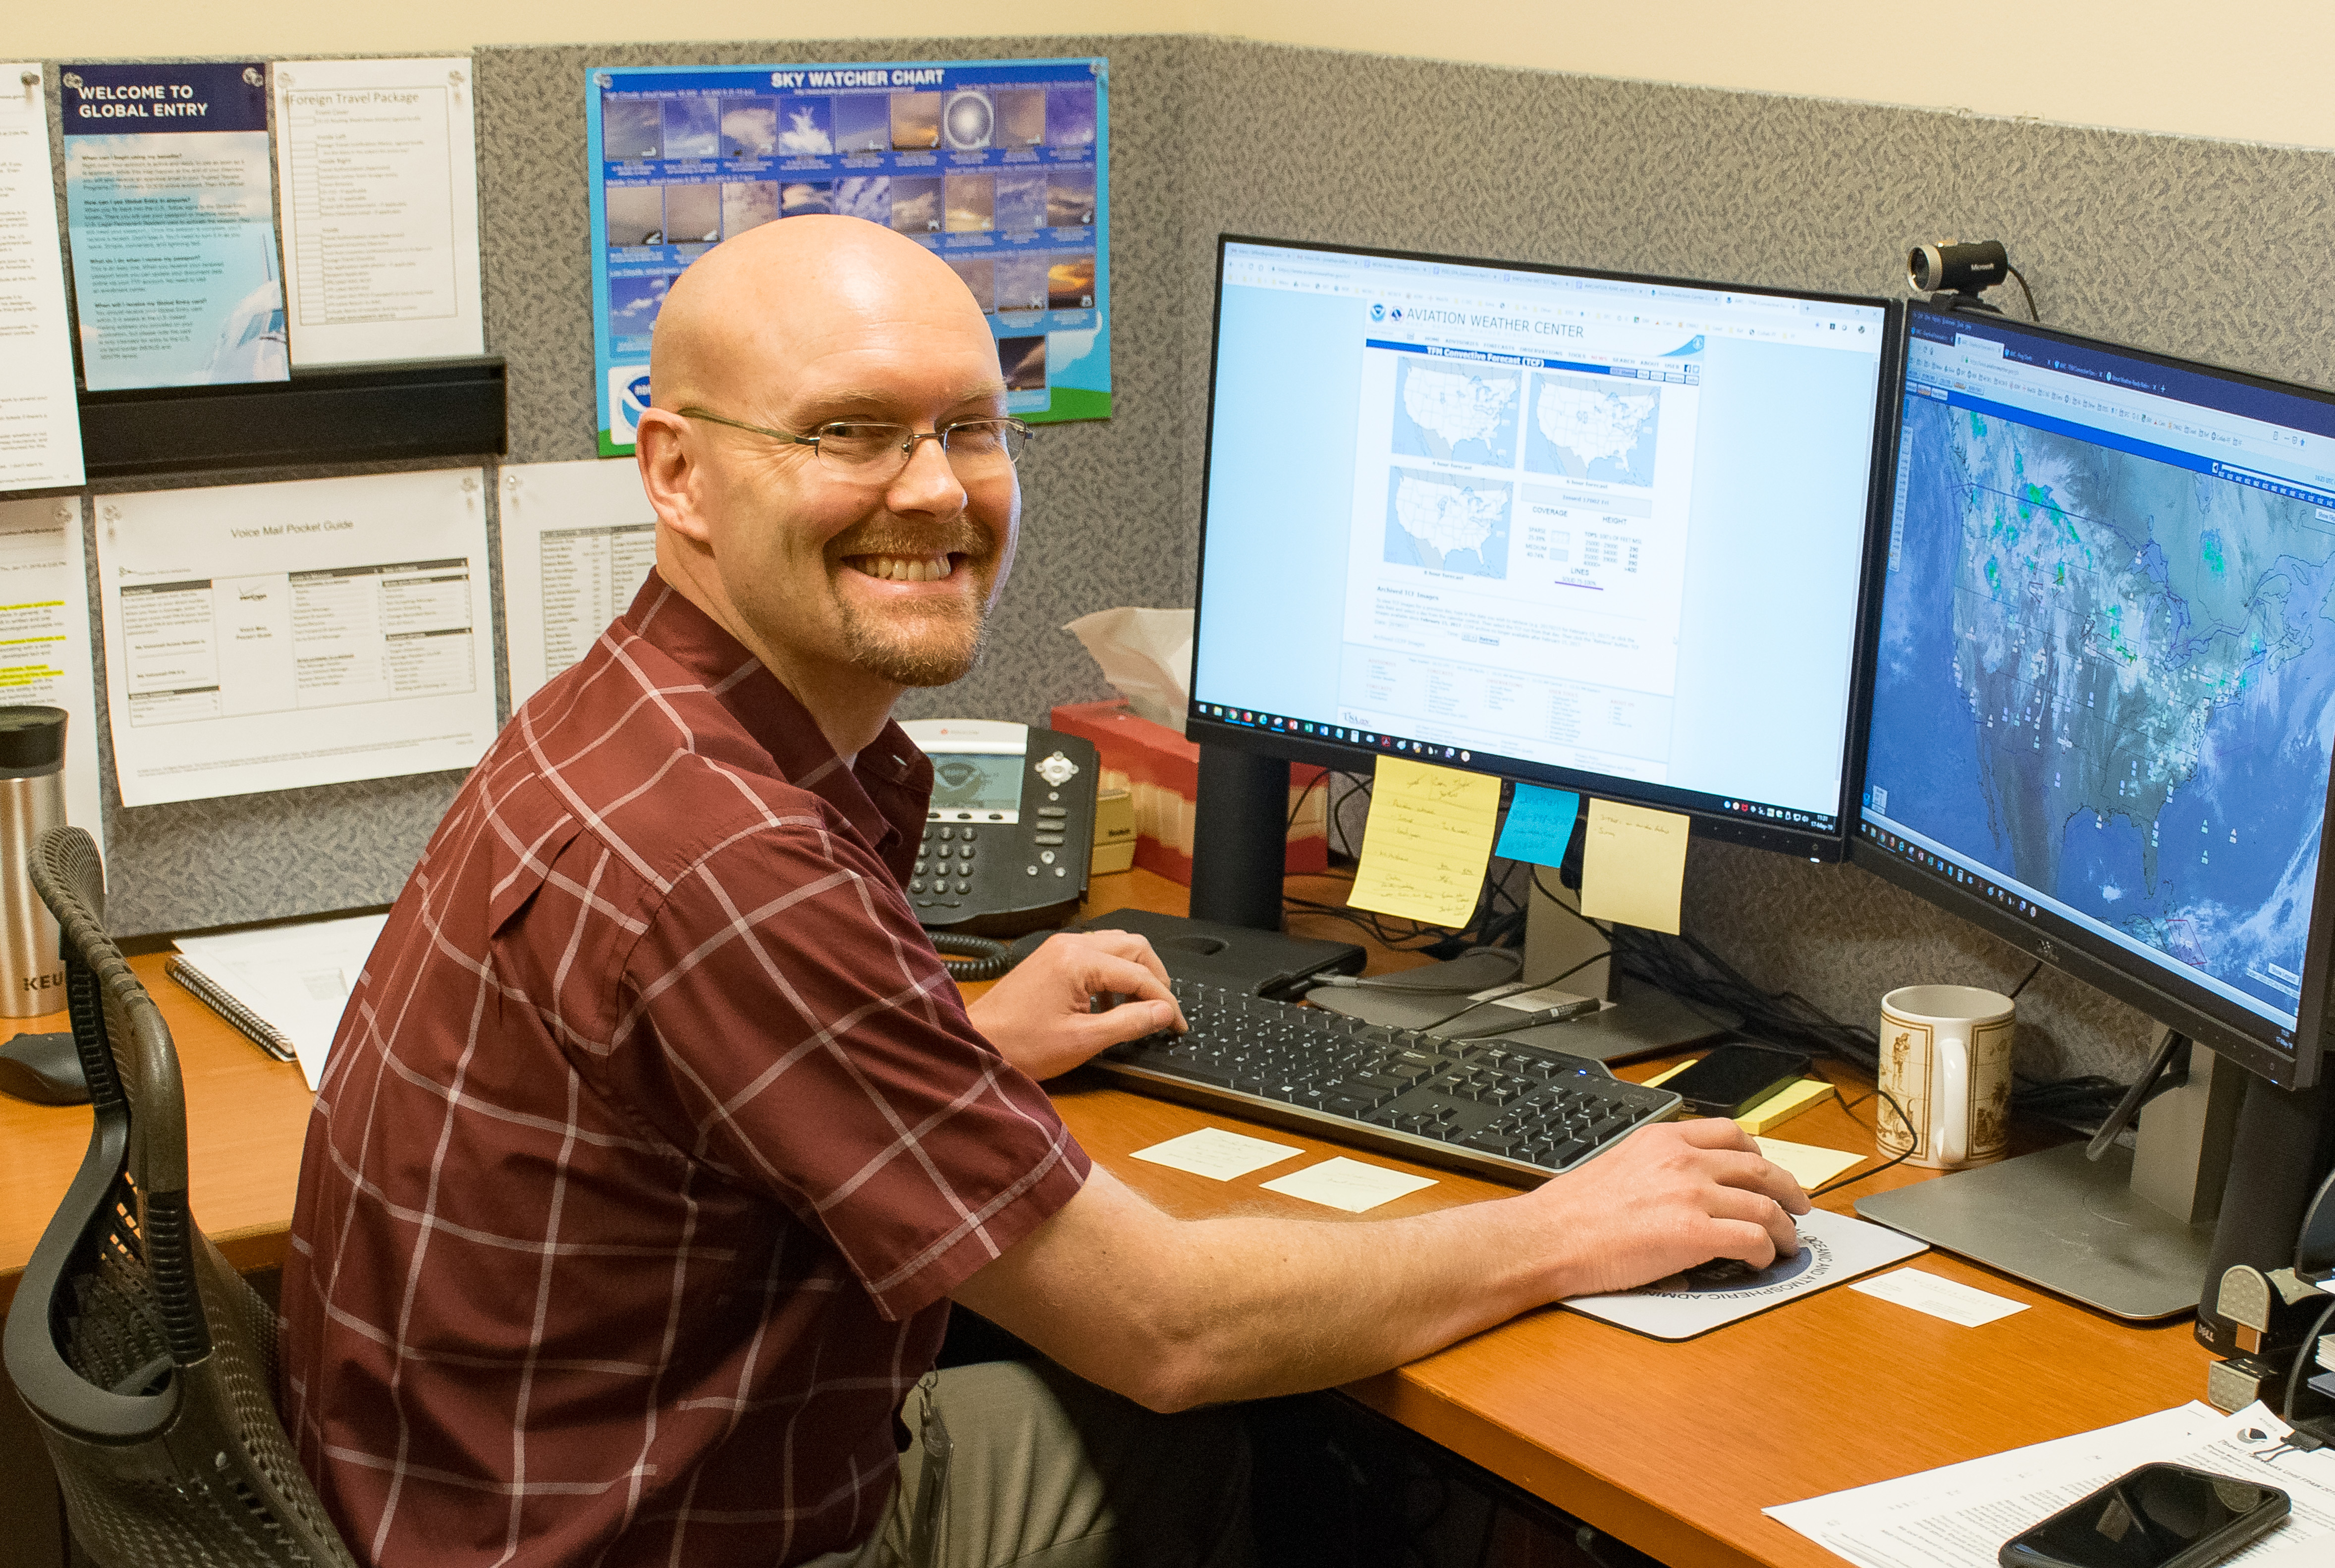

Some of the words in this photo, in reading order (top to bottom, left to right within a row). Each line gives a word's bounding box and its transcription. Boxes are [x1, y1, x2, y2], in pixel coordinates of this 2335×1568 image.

[771, 72, 805, 88] SKY
[809, 70, 888, 87] WATCHER
[892, 69, 945, 84] CHART
[79, 86, 165, 100] WELCOME
[169, 85, 193, 99] TO
[290, 94, 333, 106] Foreign
[337, 92, 371, 104] Travel
[374, 91, 419, 104] Package
[79, 104, 149, 118] GLOBAL
[154, 103, 208, 117] ENTRY
[1407, 307, 1465, 325] AVIATION
[1470, 314, 1529, 332] WEATHER
[1534, 321, 1584, 338] CENTER
[1445, 338, 1478, 347] ADVISORIES
[1483, 342, 1515, 351] FORECASTS
[1520, 347, 1563, 356] OBSERVATIONS
[1427, 346, 1442, 356] TFM
[1444, 348, 1485, 361] Convective
[1487, 353, 1520, 365] Forecast
[1521, 357, 1544, 368] (TCF)
[1532, 506, 1568, 517] COVERAGE
[1602, 516, 1627, 526] HEIGHT
[230, 527, 260, 538] Voice
[263, 525, 283, 535] Mail
[286, 523, 320, 534] Pocket
[324, 520, 354, 532] Guide
[1442, 573, 1464, 581] forecast
[1571, 567, 1590, 576] LINES
[1377, 586, 1403, 595] Archived
[1417, 592, 1439, 601] Images
[24, 972, 63, 991] KEU
[1803, 1235, 1833, 1263] OCEANIC
[1815, 1263, 1832, 1276] AND
[1708, 1275, 1817, 1299] ATMOSPHERIC
[2282, 1468, 2300, 1480] Until
[2299, 1475, 2323, 1491] FPAW
